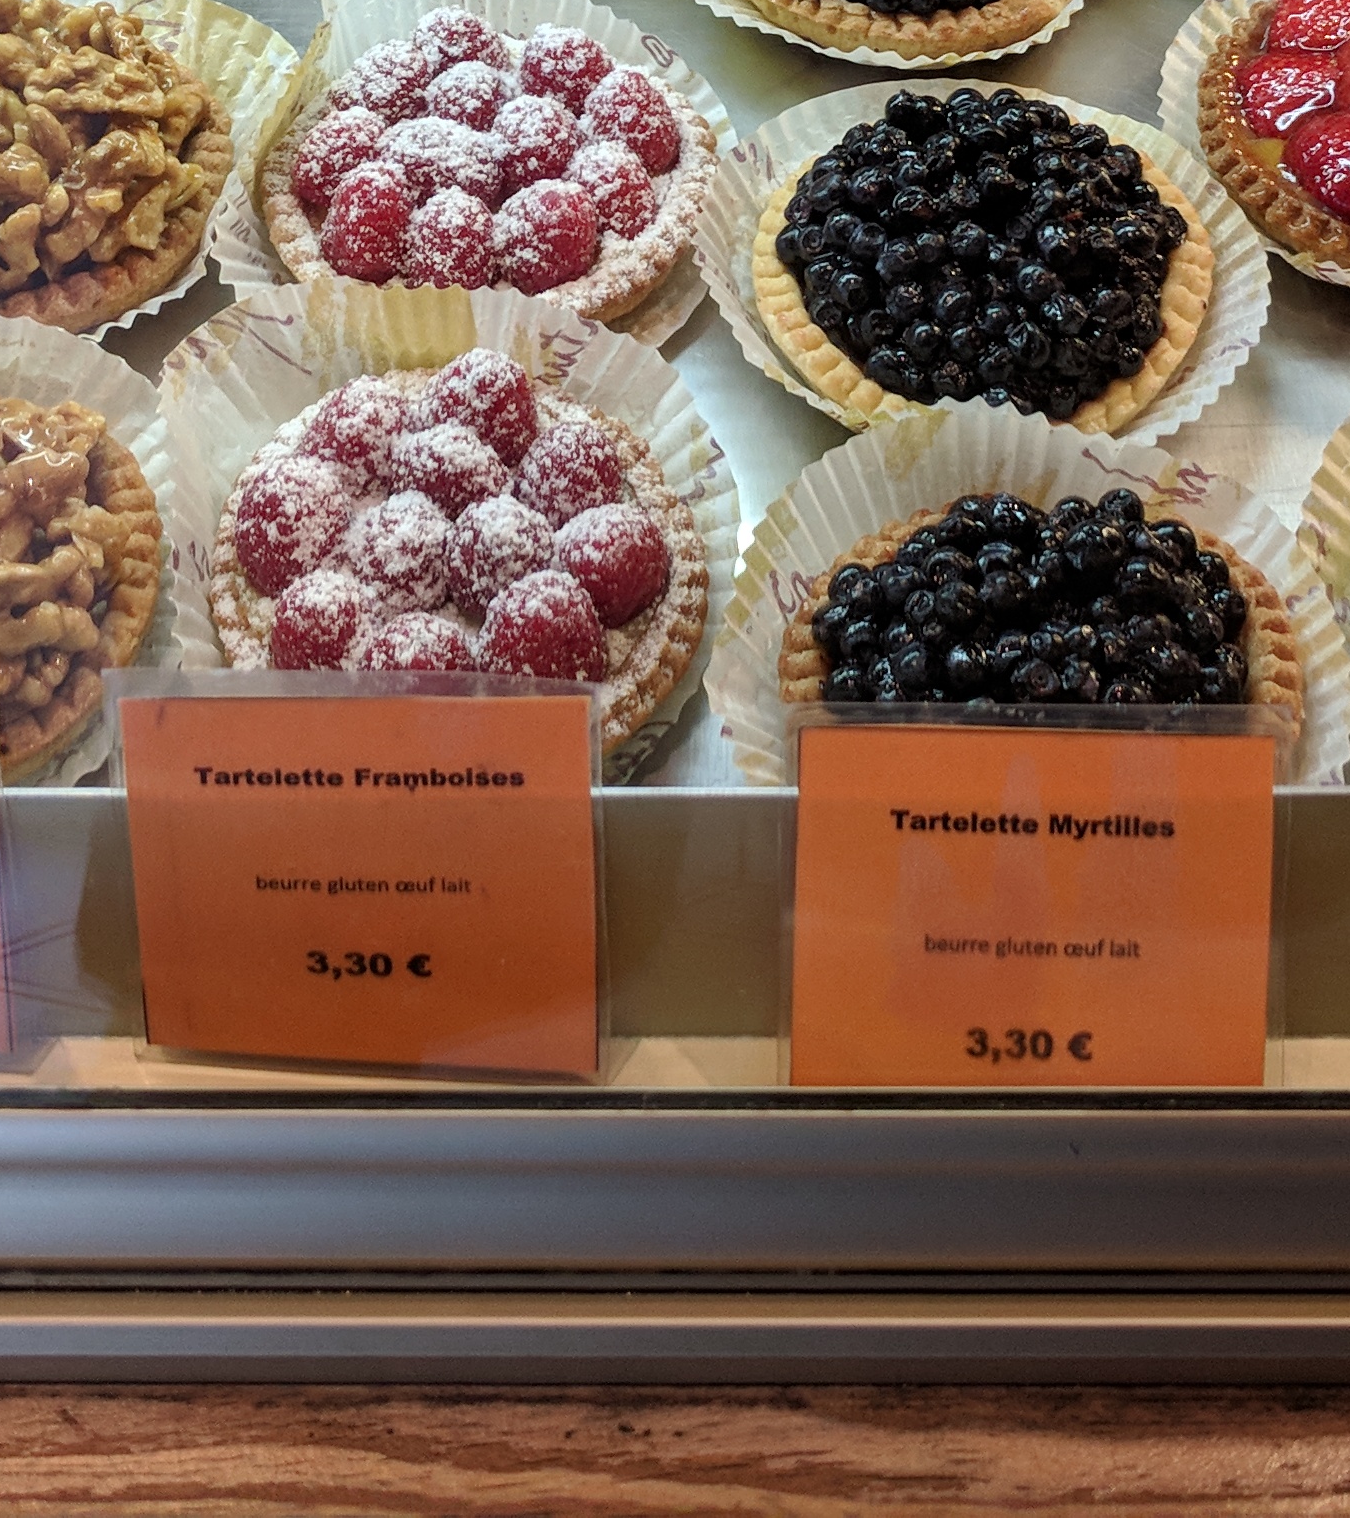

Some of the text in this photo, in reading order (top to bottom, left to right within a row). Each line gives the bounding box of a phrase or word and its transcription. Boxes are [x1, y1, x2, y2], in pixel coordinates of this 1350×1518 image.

[193, 766, 525, 788] Tartelette Framboises
[889, 808, 1176, 841] Tartelette Myrtilles
[256, 875, 472, 896] beurre gluten œuf lait
[923, 933, 1141, 958] beurre gluten œuf lait
[306, 950, 433, 980] 3,30 €
[965, 1027, 1094, 1063] 3,30 €
